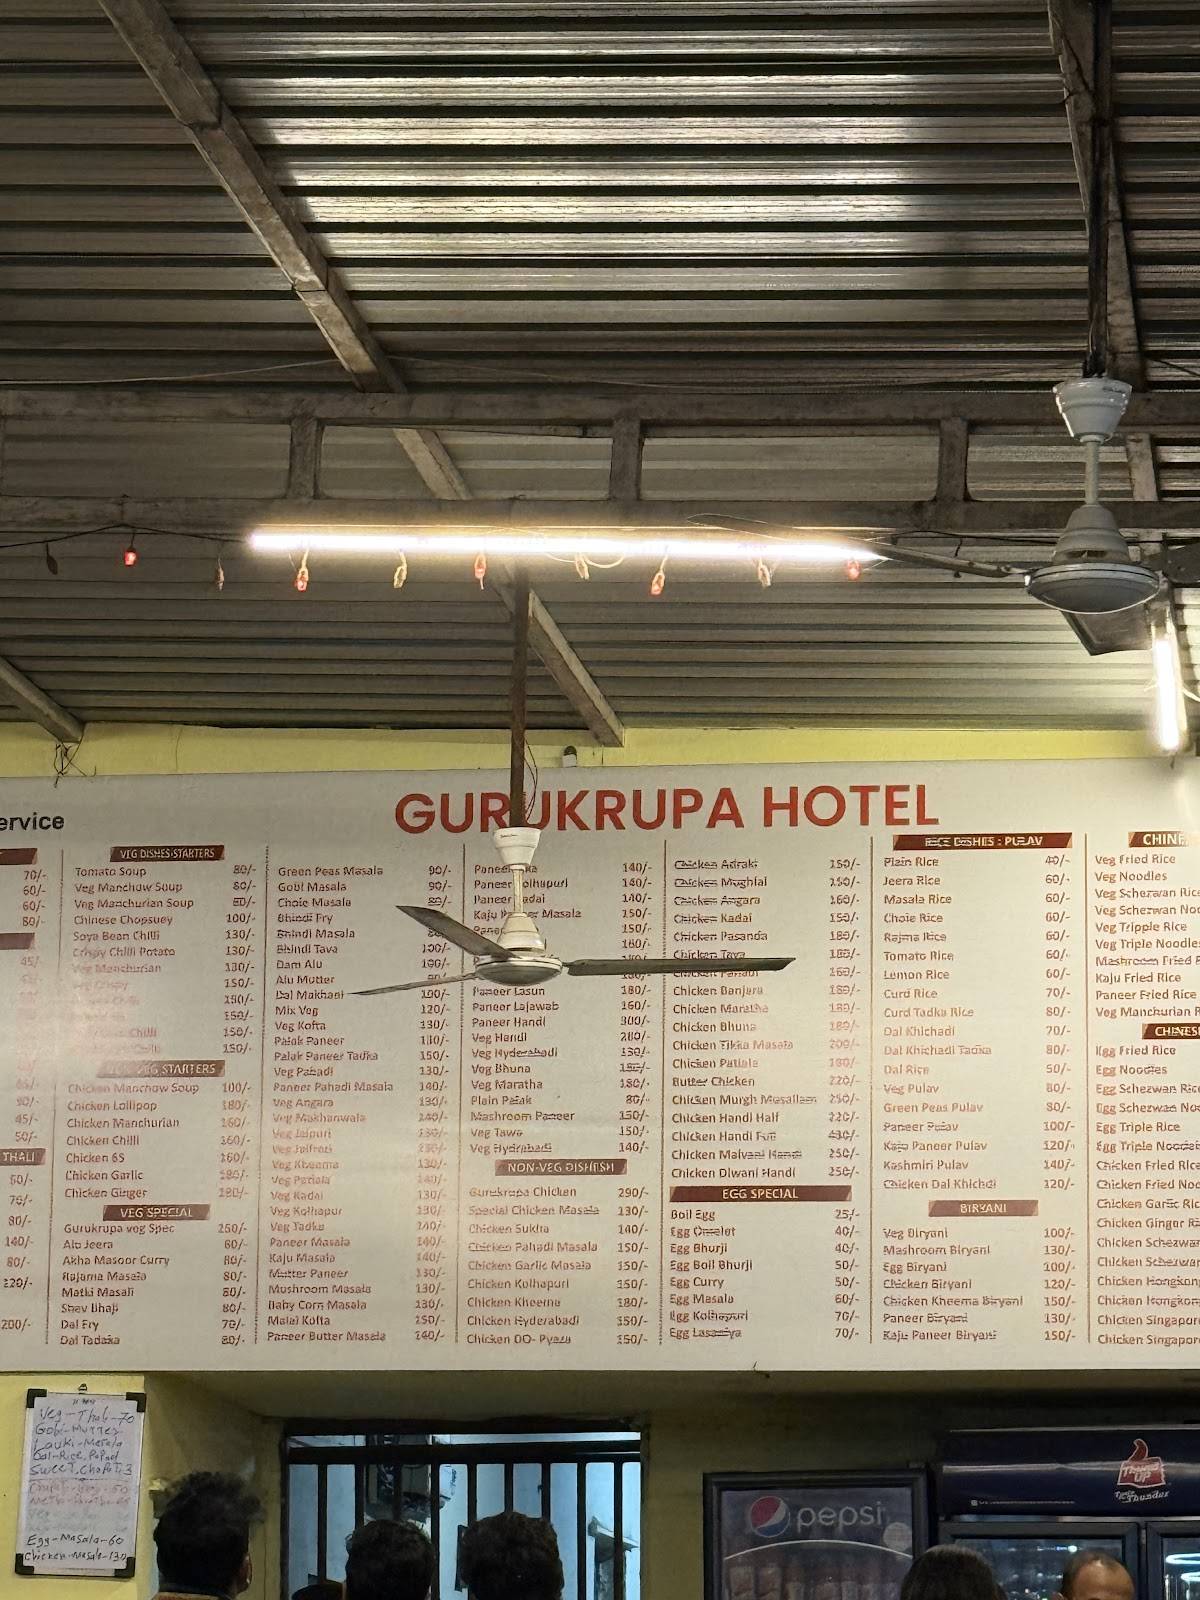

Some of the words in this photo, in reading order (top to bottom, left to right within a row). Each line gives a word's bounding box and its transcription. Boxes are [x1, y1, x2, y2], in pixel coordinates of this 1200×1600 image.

[395, 787, 745, 833] GURUKRUPA
[763, 784, 939, 828] HOTEL
[916, 857, 939, 866] Rice
[1152, 854, 1175, 864] Rice
[24, 870, 48, 880] 70/-
[119, 867, 147, 878] Soup
[344, 866, 383, 876] Masala
[883, 877, 912, 886] Jeera
[917, 877, 940, 885] Rice
[1045, 874, 1070, 885] 60/-
[1096, 872, 1116, 883] Veg
[1120, 871, 1167, 880] Noodles
[75, 884, 94, 894] Veg
[155, 883, 183, 894] Soup
[307, 883, 346, 891] Masala
[428, 882, 451, 891] 90/-
[474, 880, 512, 889] Paneer
[884, 895, 925, 904] Masala
[929, 895, 952, 904] Rice
[1045, 893, 1070, 904] 60/-
[167, 899, 194, 909] Soup
[474, 910, 497, 921] Kaju
[543, 909, 581, 918] Masala
[622, 909, 652, 919] 150/-
[1095, 906, 1116, 917] Veg
[74, 915, 116, 924] Chinese
[317, 914, 333, 924] Fry
[721, 914, 752, 922] Kadai
[1096, 922, 1116, 934] Veg
[1164, 922, 1187, 931] Rice
[225, 929, 255, 940] 130/-
[316, 929, 355, 938] Masala
[1096, 939, 1116, 951] Veg
[884, 952, 926, 961] Tomato
[926, 970, 949, 979] Rice
[1046, 969, 1071, 980] 60/-
[1096, 973, 1120, 984] Kaju
[1125, 972, 1153, 983] Fried
[1158, 973, 1181, 982] Rice
[515, 987, 544, 995] Lasun
[674, 987, 717, 995] Chicken
[884, 988, 910, 998] Curd
[914, 989, 938, 998] Rice
[1046, 988, 1071, 1000] 70/-
[1096, 990, 1136, 1000] Paneer
[1174, 990, 1196, 999] Rice
[276, 1007, 295, 1015] Mix
[299, 1007, 319, 1016] Veg
[421, 1005, 450, 1014] 120/-
[673, 1005, 716, 1013] Chicken
[473, 1017, 510, 1026] Paneer
[275, 1022, 294, 1032] Veg
[673, 1023, 716, 1032] Chicken
[884, 1027, 902, 1036] Dal
[1047, 1026, 1071, 1037] 70/-
[673, 1041, 716, 1050] Chicken
[1120, 1045, 1148, 1055] Fried
[1152, 1046, 1176, 1055] Rice
[420, 1051, 449, 1061] 150/-
[274, 1068, 293, 1077] Veg
[419, 1067, 449, 1076] 130/-
[884, 1065, 902, 1074] Dal
[172, 1083, 199, 1094] Soup
[315, 1082, 350, 1091] Pahadi
[472, 1080, 491, 1090] Veg
[495, 1079, 542, 1089] Maratha
[908, 1084, 939, 1094] Pulav
[720, 1095, 756, 1106] Murgh
[884, 1103, 918, 1112] Green
[922, 1103, 948, 1112] Peas
[67, 1119, 109, 1128] Chicken
[113, 1118, 179, 1128] Manchurian
[720, 1113, 752, 1123] Handi
[756, 1113, 779, 1123] Half
[1044, 1121, 1075, 1133] 100/-
[1096, 1123, 1116, 1134] Egg
[1120, 1122, 1152, 1134] Triple
[1157, 1122, 1180, 1132] Rice
[67, 1136, 109, 1145] Chicken
[720, 1132, 752, 1141] Handi
[956, 1142, 987, 1151] Pulav
[1044, 1140, 1075, 1152] 120/-
[66, 1153, 108, 1162] Chicken
[672, 1151, 715, 1160] Chicken
[937, 1160, 968, 1170] Pulav
[1146, 1160, 1174, 1171] Fried
[111, 1170, 144, 1180] Garlic
[672, 1169, 715, 1178] Chicken
[932, 1180, 950, 1189] Dal
[1044, 1178, 1075, 1190] 120/-
[1146, 1179, 1174, 1189] Fried
[723, 1190, 746, 1199] EGG
[751, 1189, 798, 1199] SPECIAL
[121, 1208, 143, 1217] VEG
[512, 1205, 555, 1215] Chicken
[671, 1210, 691, 1219] Boil
[1097, 1218, 1141, 1228] Chicken
[84, 1240, 113, 1249] Jeera
[1097, 1238, 1141, 1248] Chicken
[618, 1243, 648, 1254] 150/-
[671, 1244, 690, 1255] Egg
[694, 1244, 727, 1255] Bhurji
[950, 1245, 989, 1256] Biryani
[95, 1256, 137, 1265] Masoor
[671, 1261, 690, 1271] Egg
[694, 1260, 714, 1270] Boil
[719, 1260, 752, 1271] Bhurji
[883, 1263, 903, 1274] Egg
[907, 1262, 946, 1274] Biryani
[1044, 1261, 1075, 1274] 100/-
[310, 1270, 348, 1278] Paneer
[468, 1279, 511, 1289] Chicken
[515, 1279, 569, 1290] Kolhapuri
[693, 1277, 724, 1289] Curry
[835, 1276, 859, 1288] 50/-
[932, 1279, 971, 1290] Biryani
[1098, 1276, 1142, 1286] Chicken
[269, 1285, 328, 1294] Mushroom
[332, 1285, 371, 1293] Masala
[327, 1301, 367, 1310] Masala
[468, 1316, 510, 1326] Chicken
[883, 1314, 926, 1323] Paneer
[1044, 1313, 1075, 1325] 130/-
[2, 1320, 30, 1331] 200/-
[61, 1320, 79, 1329] Dal
[309, 1332, 342, 1341] Butter
[347, 1332, 386, 1341] Masala
[670, 1328, 689, 1339] Egg
[835, 1328, 859, 1339] 70/-
[912, 1331, 951, 1340] Paneer
[1044, 1330, 1075, 1342] 150/-
[60, 1336, 78, 1345] Dal
[467, 1335, 509, 1344] Chicken
[797, 1502, 882, 1532] pepsi
